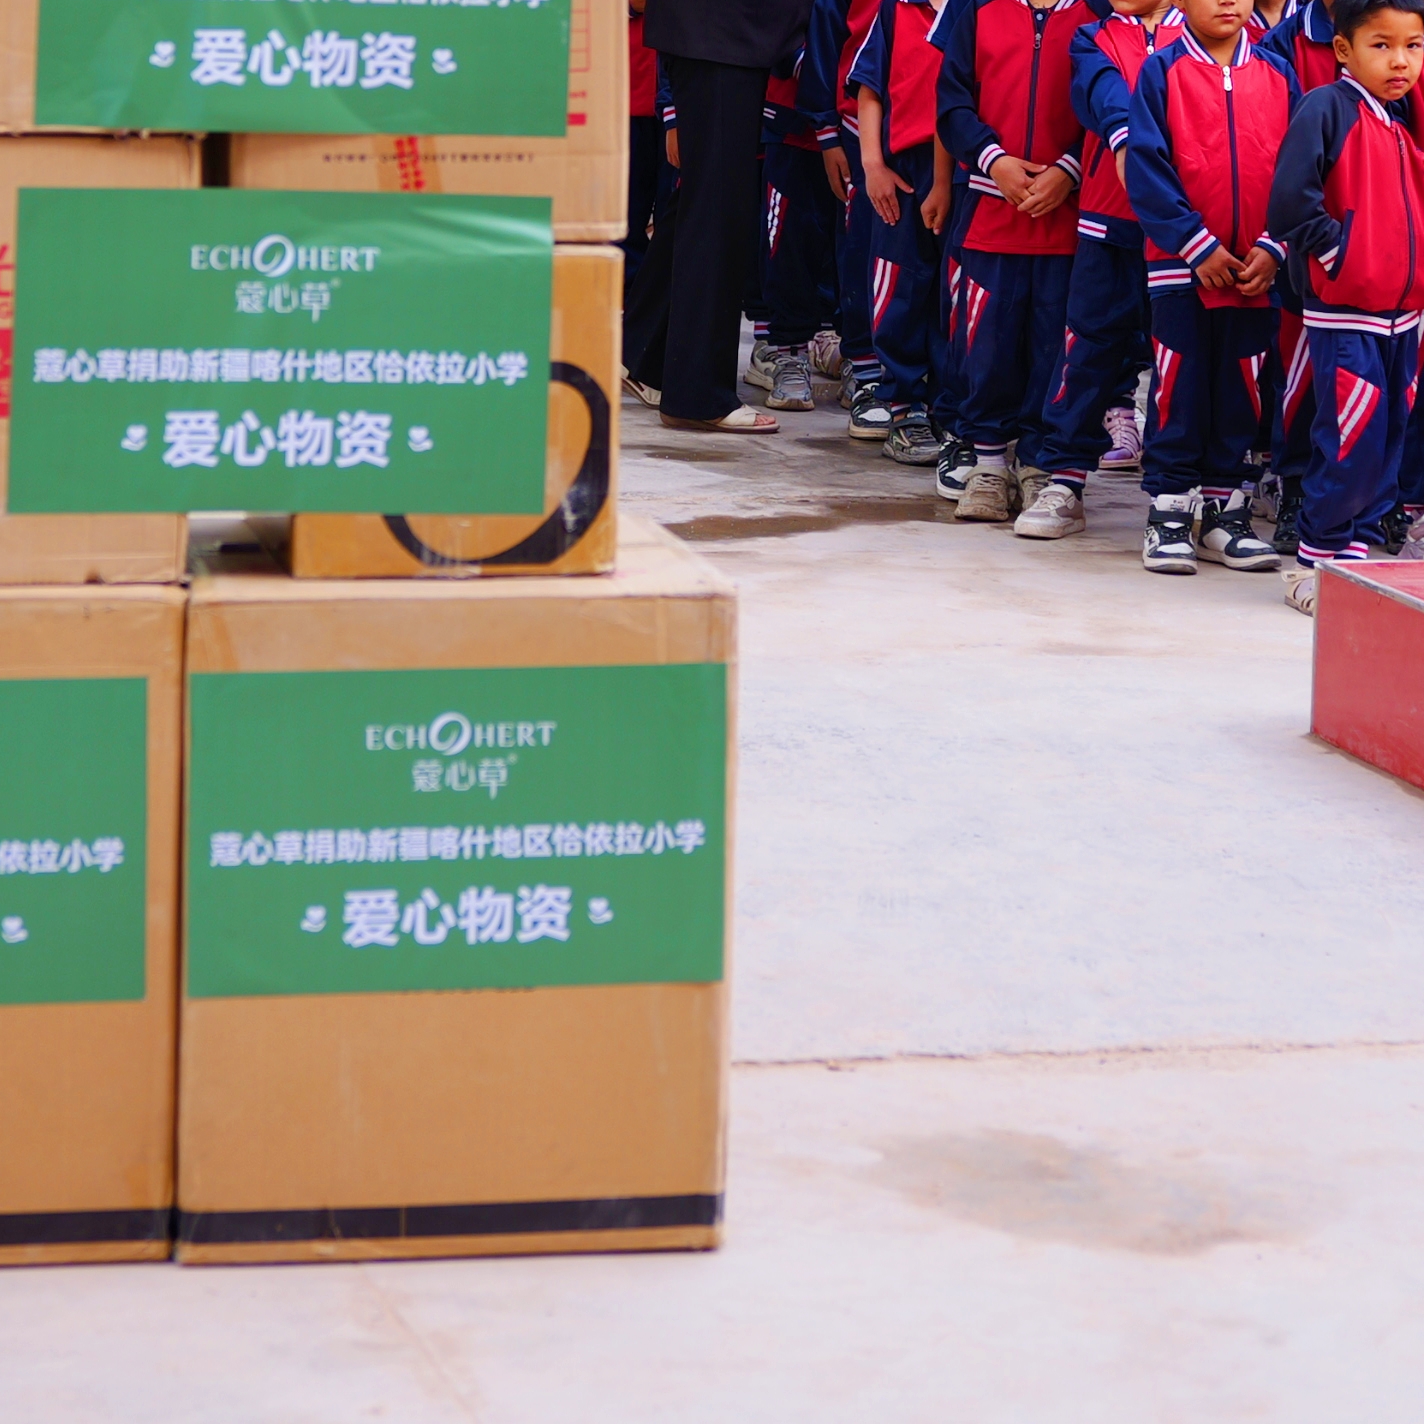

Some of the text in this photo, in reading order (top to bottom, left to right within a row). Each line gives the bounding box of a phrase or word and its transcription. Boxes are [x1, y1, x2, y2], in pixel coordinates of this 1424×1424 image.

[190, 28, 416, 90] 爱心物资
[190, 234, 381, 278] ECHOHERT
[162, 410, 392, 469] 爱心物资
[365, 711, 557, 756] ECHOHERT
[342, 883, 572, 948] 爱心物资
